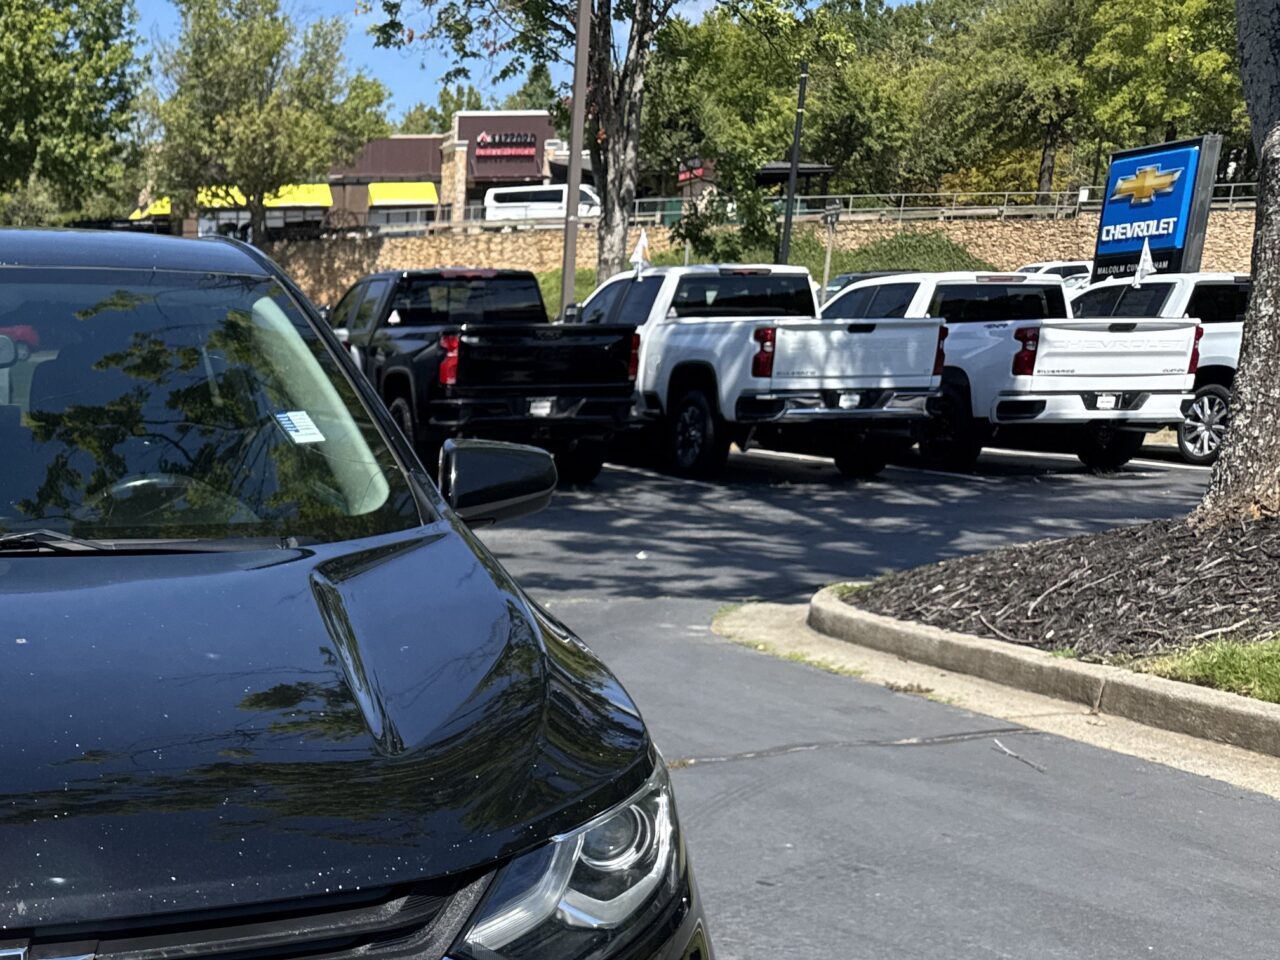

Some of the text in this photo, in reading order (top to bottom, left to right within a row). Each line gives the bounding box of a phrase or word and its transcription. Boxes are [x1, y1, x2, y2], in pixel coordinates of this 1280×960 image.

[1102, 217, 1178, 242] CHEVROLET
[1097, 260, 1169, 275] MALCOLM CUNHAM
